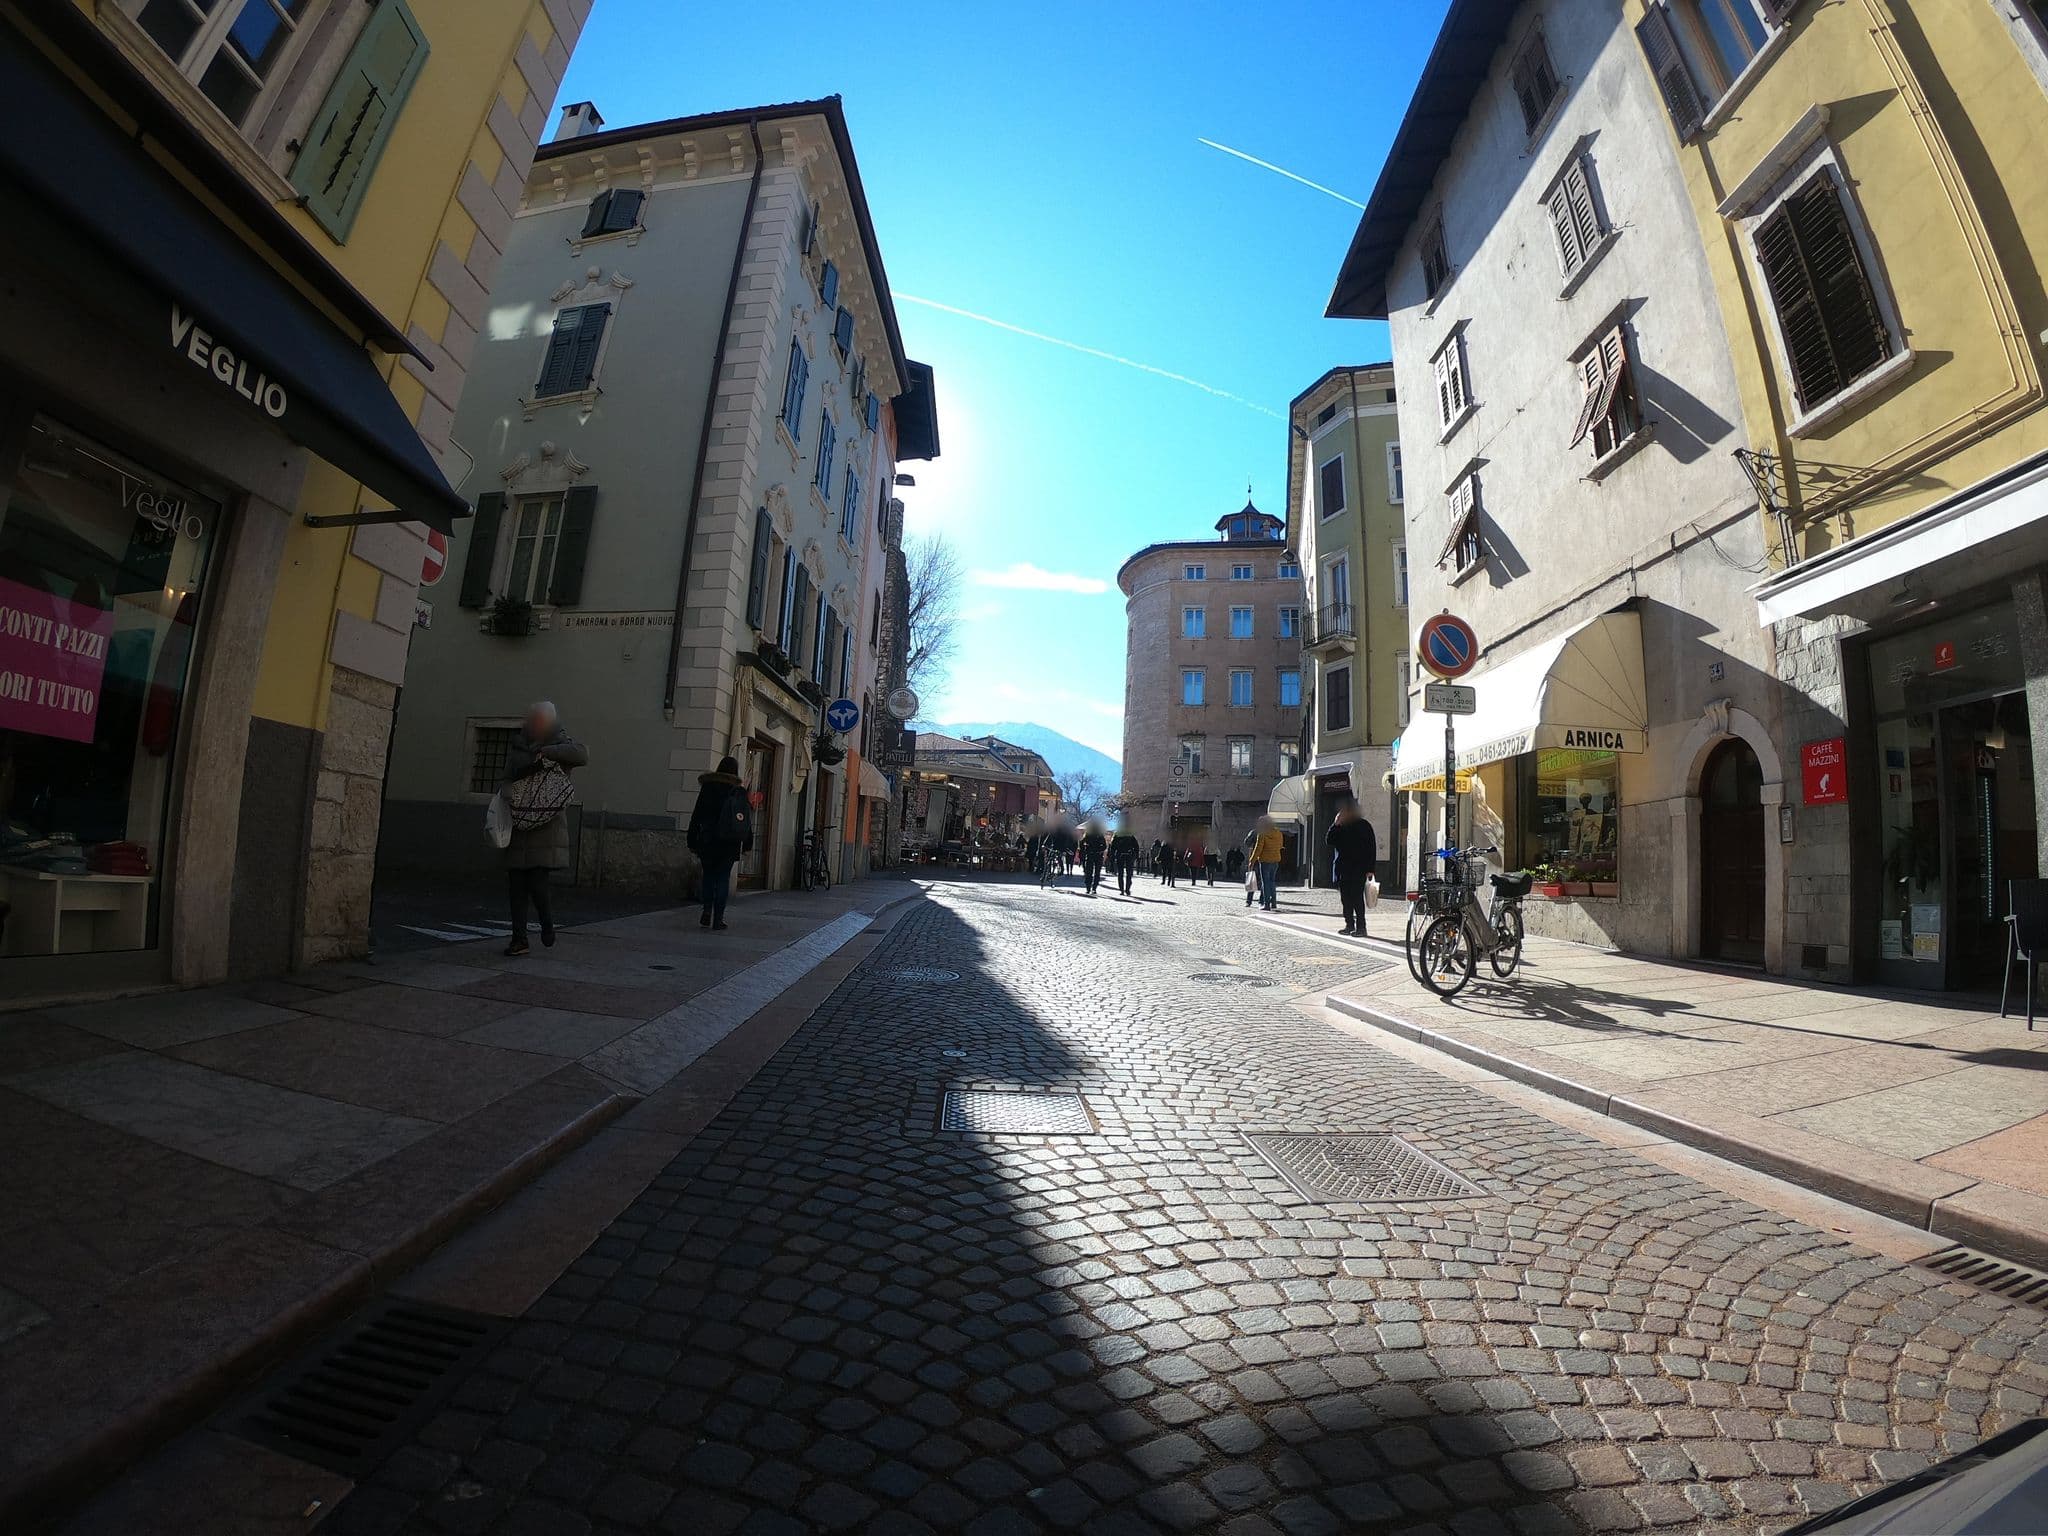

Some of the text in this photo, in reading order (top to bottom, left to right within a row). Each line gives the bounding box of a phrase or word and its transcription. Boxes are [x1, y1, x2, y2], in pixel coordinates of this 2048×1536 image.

[170, 303, 288, 419] VEGLIO
[620, 616, 645, 626] BORGO
[647, 615, 674, 626] NUOVO
[55, 623, 105, 660] PAZZI
[37, 678, 95, 716] TUTTO
[1564, 729, 1625, 751] ARNICA
[1811, 741, 1833, 756] CAFFÈ
[1466, 752, 1477, 766] TEL.
[1808, 753, 1840, 768] MAZZINI
